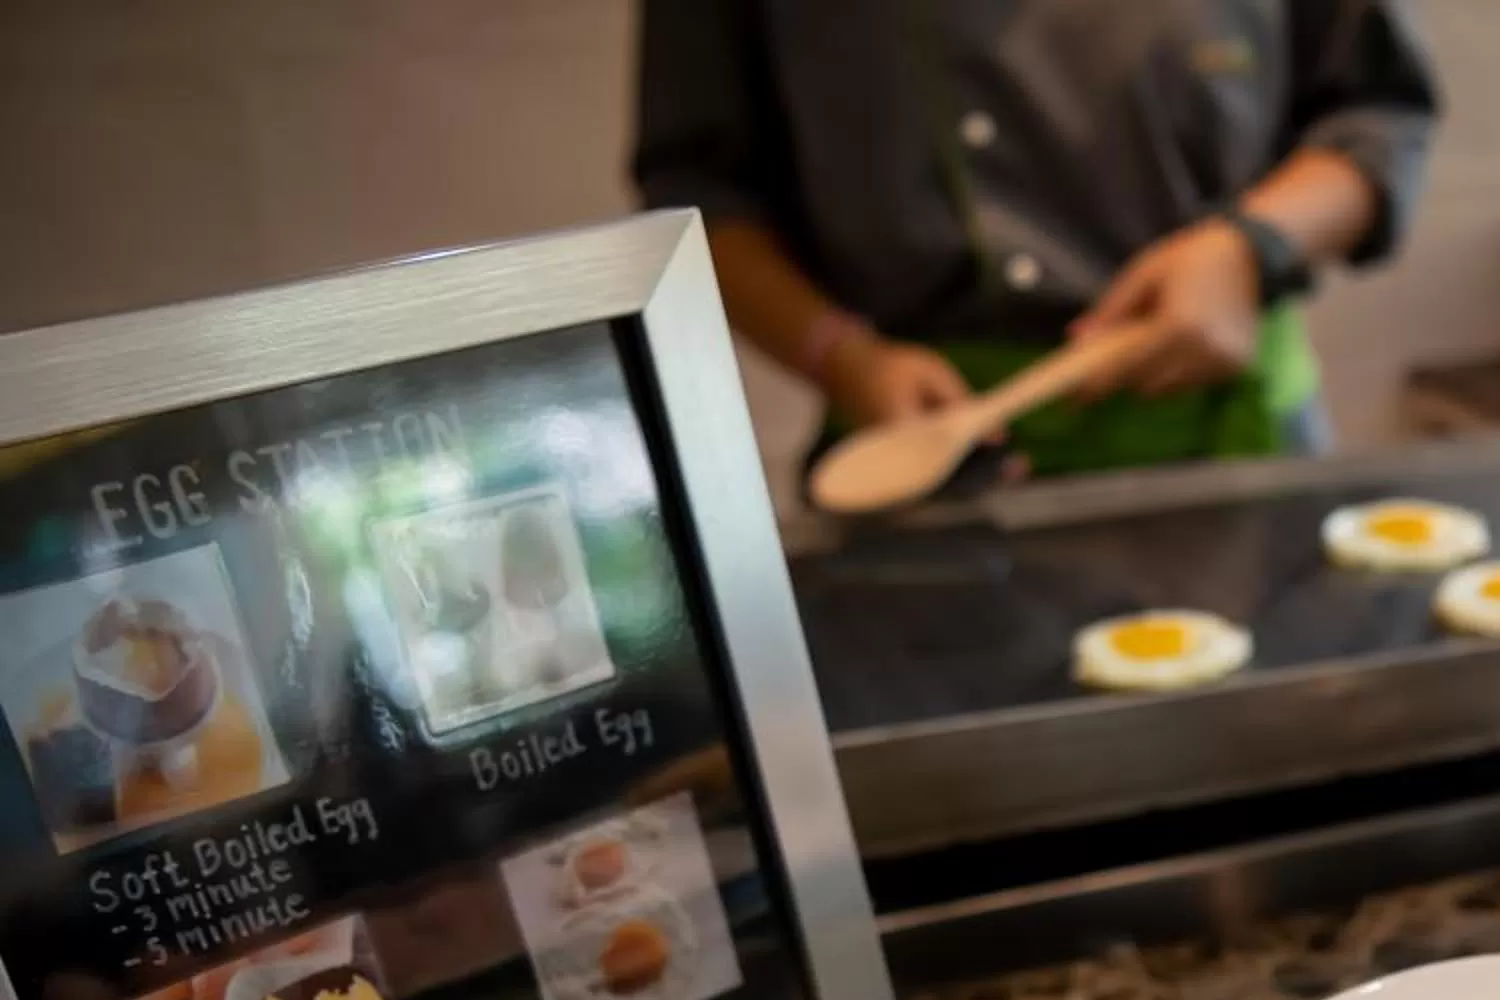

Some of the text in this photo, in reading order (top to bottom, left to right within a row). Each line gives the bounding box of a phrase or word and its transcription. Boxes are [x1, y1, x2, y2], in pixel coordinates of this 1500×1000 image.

[90, 402, 470, 546] EGG STATION
[471, 705, 654, 790] Boiled Egg
[89, 796, 379, 913] Soft Boiled Egg
